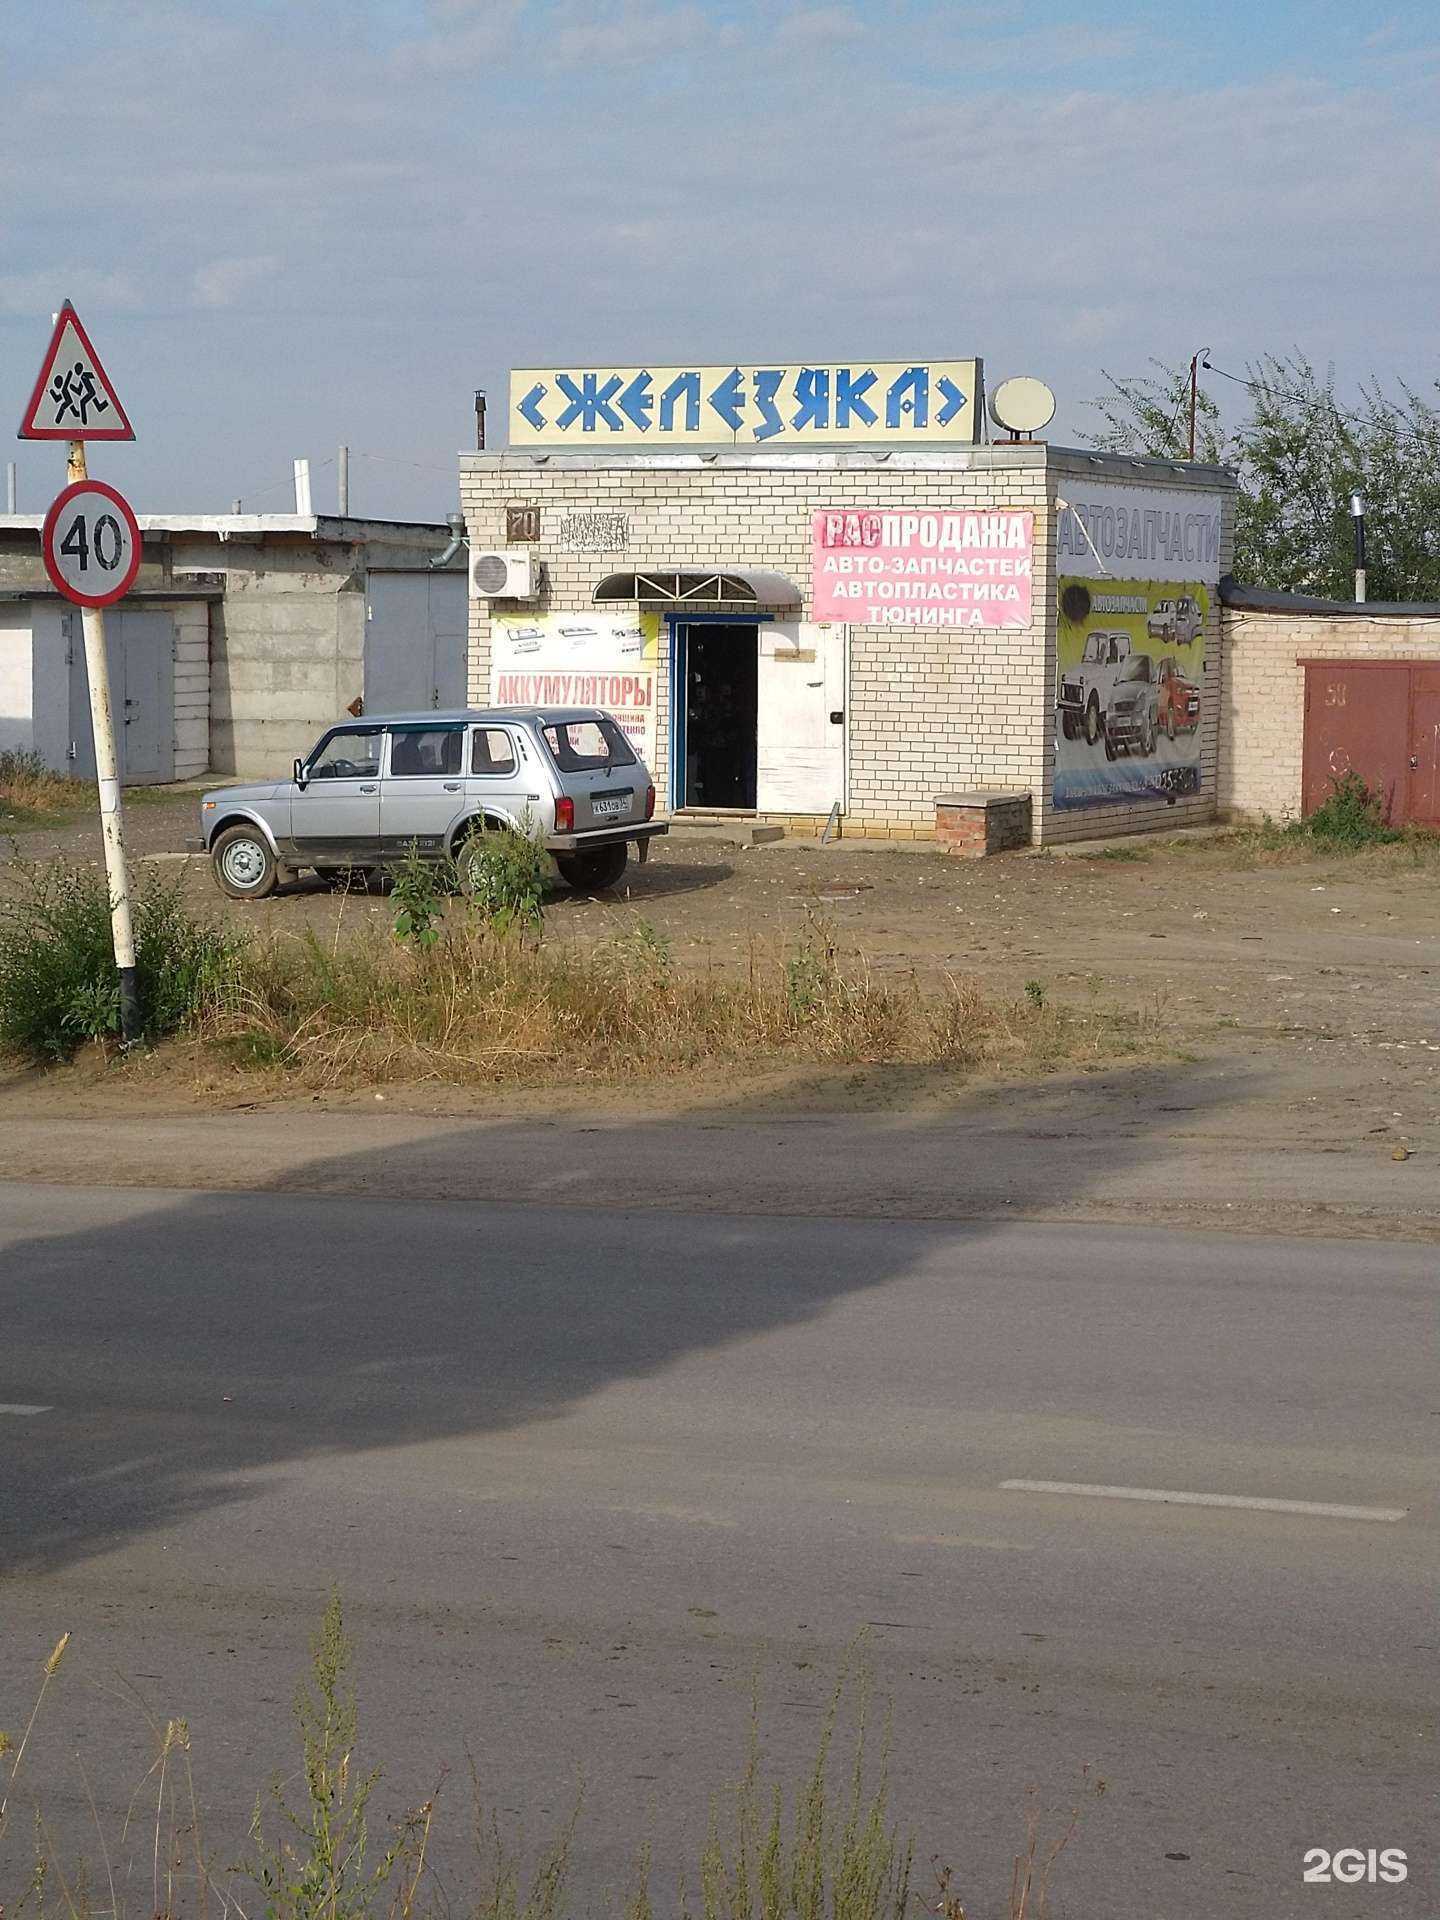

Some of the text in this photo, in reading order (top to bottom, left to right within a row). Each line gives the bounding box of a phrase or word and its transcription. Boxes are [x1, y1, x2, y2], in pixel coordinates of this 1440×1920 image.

[60, 514, 122, 571] 40
[822, 513, 1027, 553] РАСПРОДАЖА
[1057, 502, 1221, 564] АВТОЗАПЧАСТИ
[823, 556, 1032, 577] АВТО-ЗАПЧАСТЕЙ
[832, 581, 1021, 602] АВТОПЛАСТИКА
[867, 605, 985, 626] ТЮНИНГА
[497, 673, 652, 707] АККУМУЛЯТОРЫ
